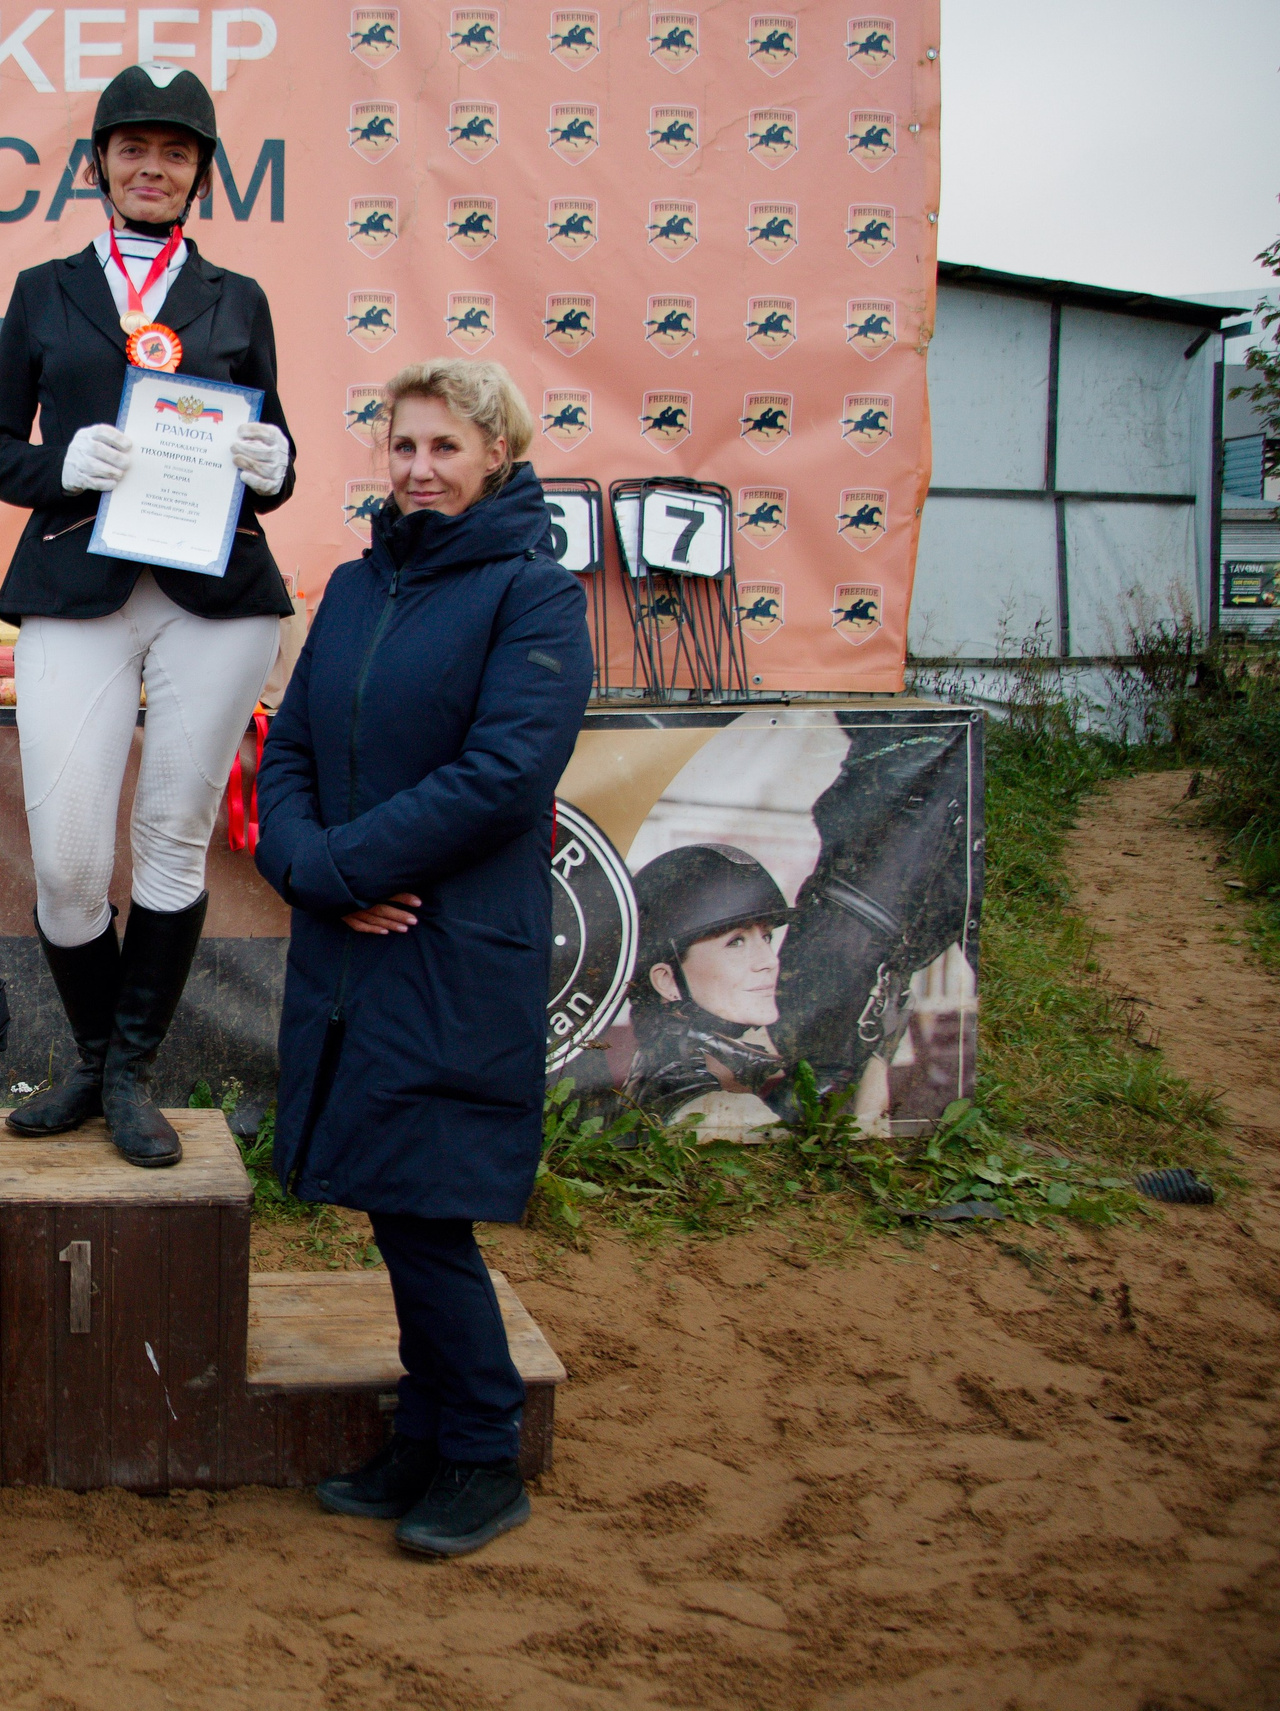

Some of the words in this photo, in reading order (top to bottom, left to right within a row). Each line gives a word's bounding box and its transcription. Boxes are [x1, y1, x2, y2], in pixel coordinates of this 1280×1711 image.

[154, 422, 213, 442] ГРАМОТА
[140, 446, 197, 464] ТИХОМИРОВА
[665, 505, 705, 564] 7
[58, 1240, 93, 1334] 1
